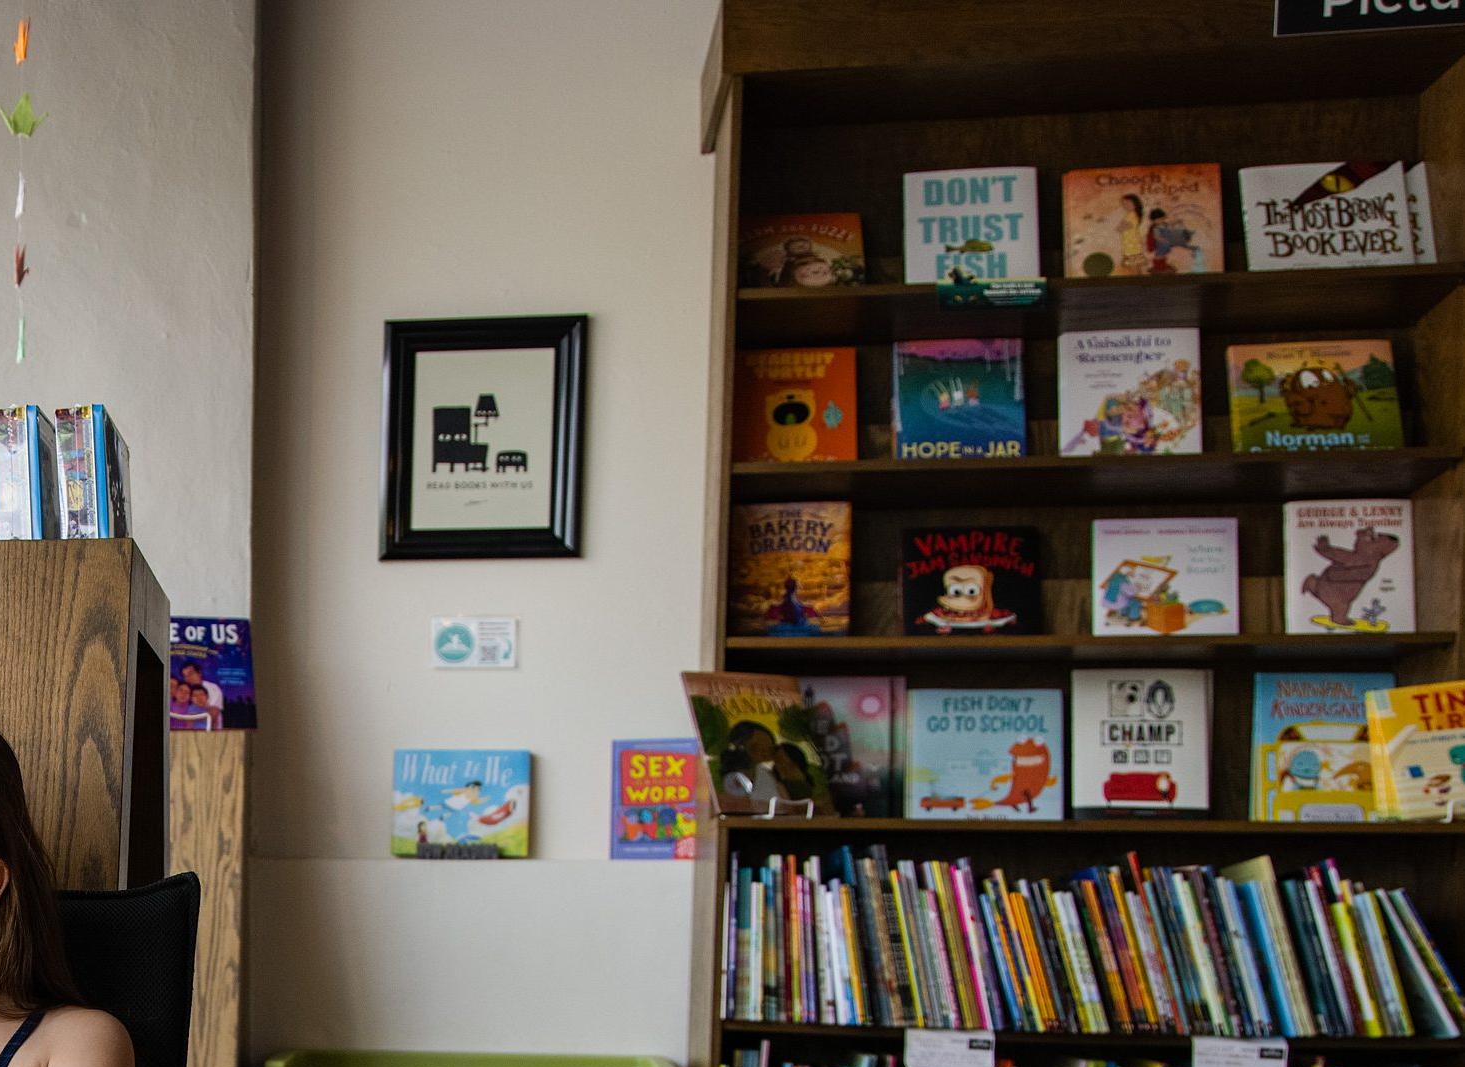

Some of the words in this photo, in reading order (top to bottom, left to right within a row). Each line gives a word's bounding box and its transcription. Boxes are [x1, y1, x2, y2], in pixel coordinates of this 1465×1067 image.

[1095, 174, 1162, 188] Chooch
[1140, 181, 1200, 196] Helped
[923, 175, 1018, 207] DON'T
[918, 213, 1024, 244] TRUST
[936, 252, 1008, 281] FISH
[1154, 335, 1172, 346] to
[1264, 431, 1356, 447] Norman
[901, 441, 962, 458] HOPE
[985, 440, 1021, 457] JAR
[426, 480, 450, 489] READ
[454, 480, 487, 489] BOOKS
[490, 480, 518, 488] WITH
[521, 480, 533, 488] US
[749, 519, 833, 538] BAKERY
[751, 535, 833, 555] DRAGON
[914, 531, 1023, 556] VAMPIRE
[185, 625, 206, 641] OF
[211, 623, 239, 644] US
[942, 696, 983, 712] FISH
[1412, 689, 1465, 714] TIN
[927, 715, 950, 732] GO
[955, 715, 976, 732] TO
[980, 714, 1048, 733] SCHOOL
[1108, 724, 1176, 742] CHAMP
[401, 752, 458, 785] What
[629, 753, 687, 779] SEX
[626, 785, 691, 803] WORD
